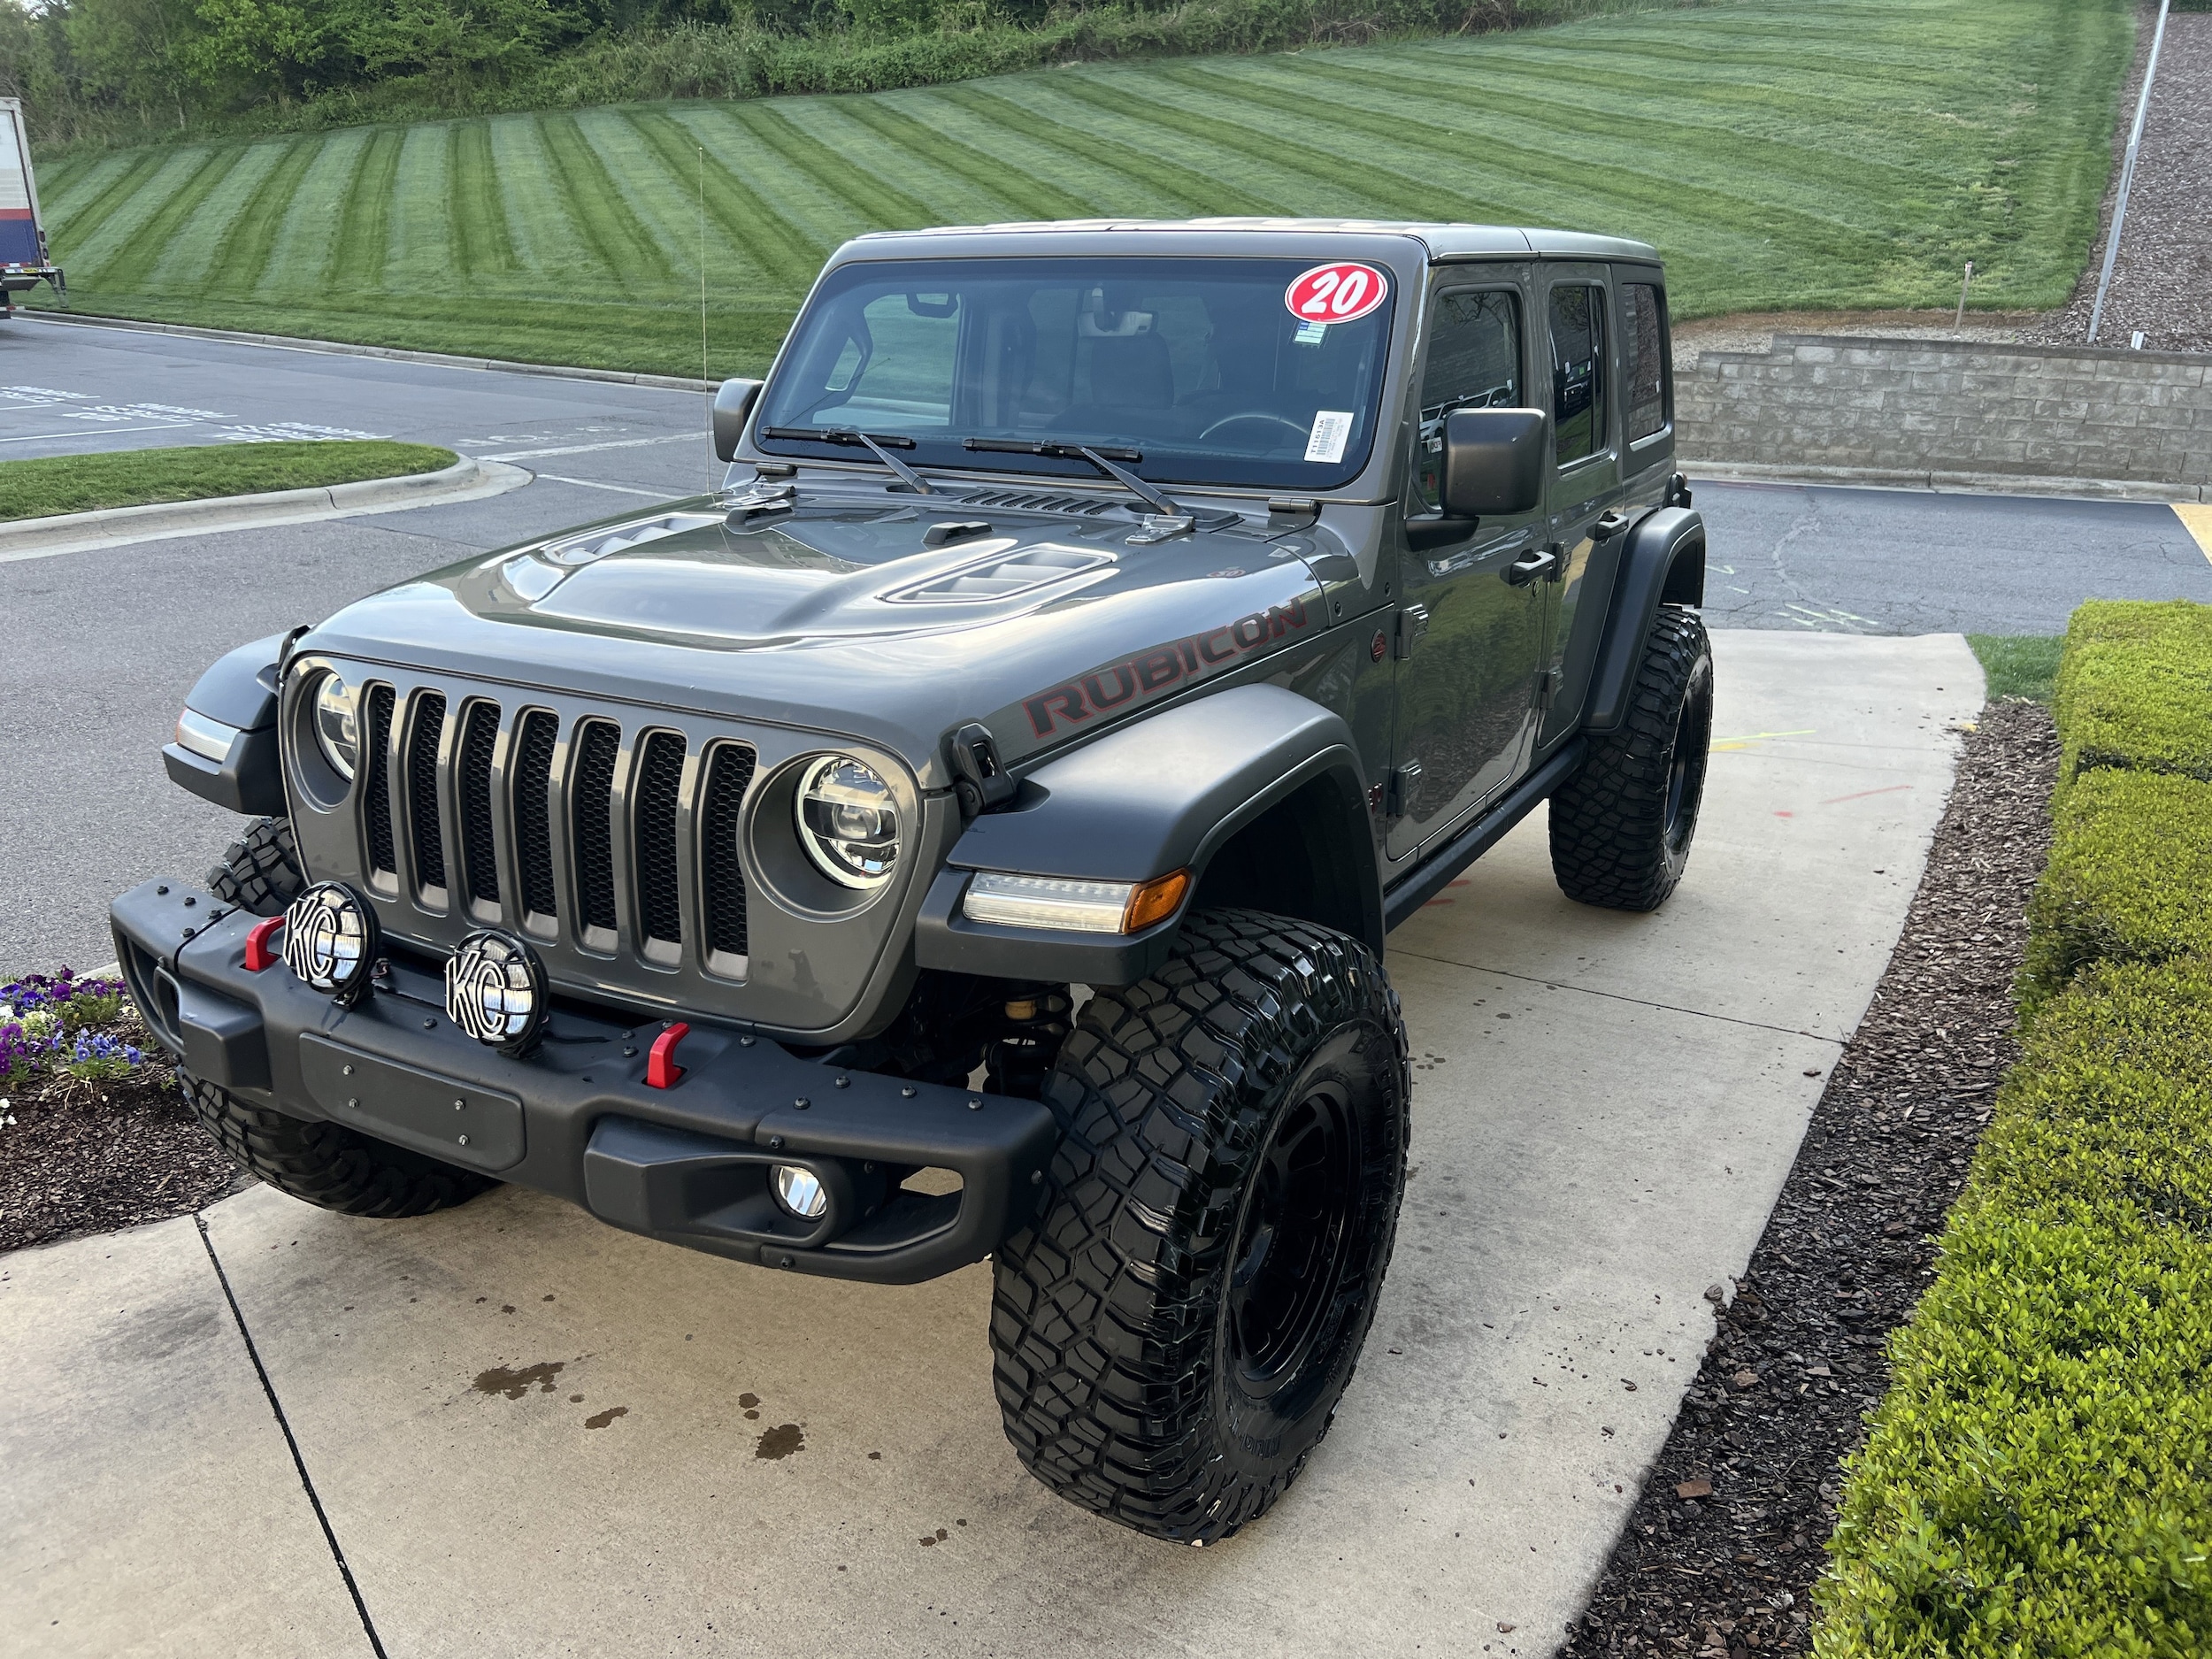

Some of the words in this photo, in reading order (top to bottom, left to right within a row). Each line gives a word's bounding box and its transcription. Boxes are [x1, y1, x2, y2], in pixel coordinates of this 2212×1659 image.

[1301, 271, 1368, 314] 20
[1022, 595, 1307, 739] RUBICON
[282, 896, 337, 981] KC
[446, 949, 505, 1039] KC
